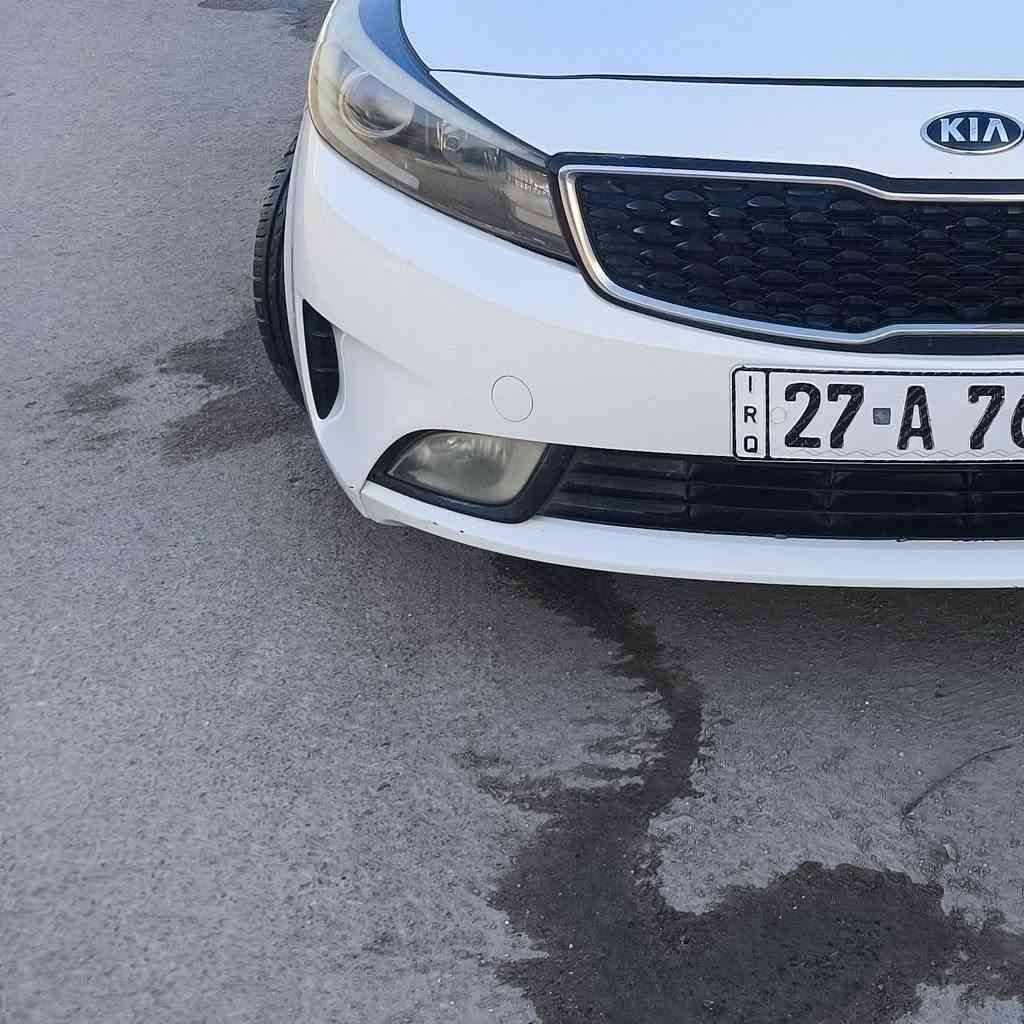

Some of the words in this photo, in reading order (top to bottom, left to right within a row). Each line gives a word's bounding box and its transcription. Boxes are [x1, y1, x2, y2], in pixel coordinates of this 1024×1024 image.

[940, 117, 1009, 142] KIA
[785, 383, 865, 449] 27
[897, 385, 934, 450] A
